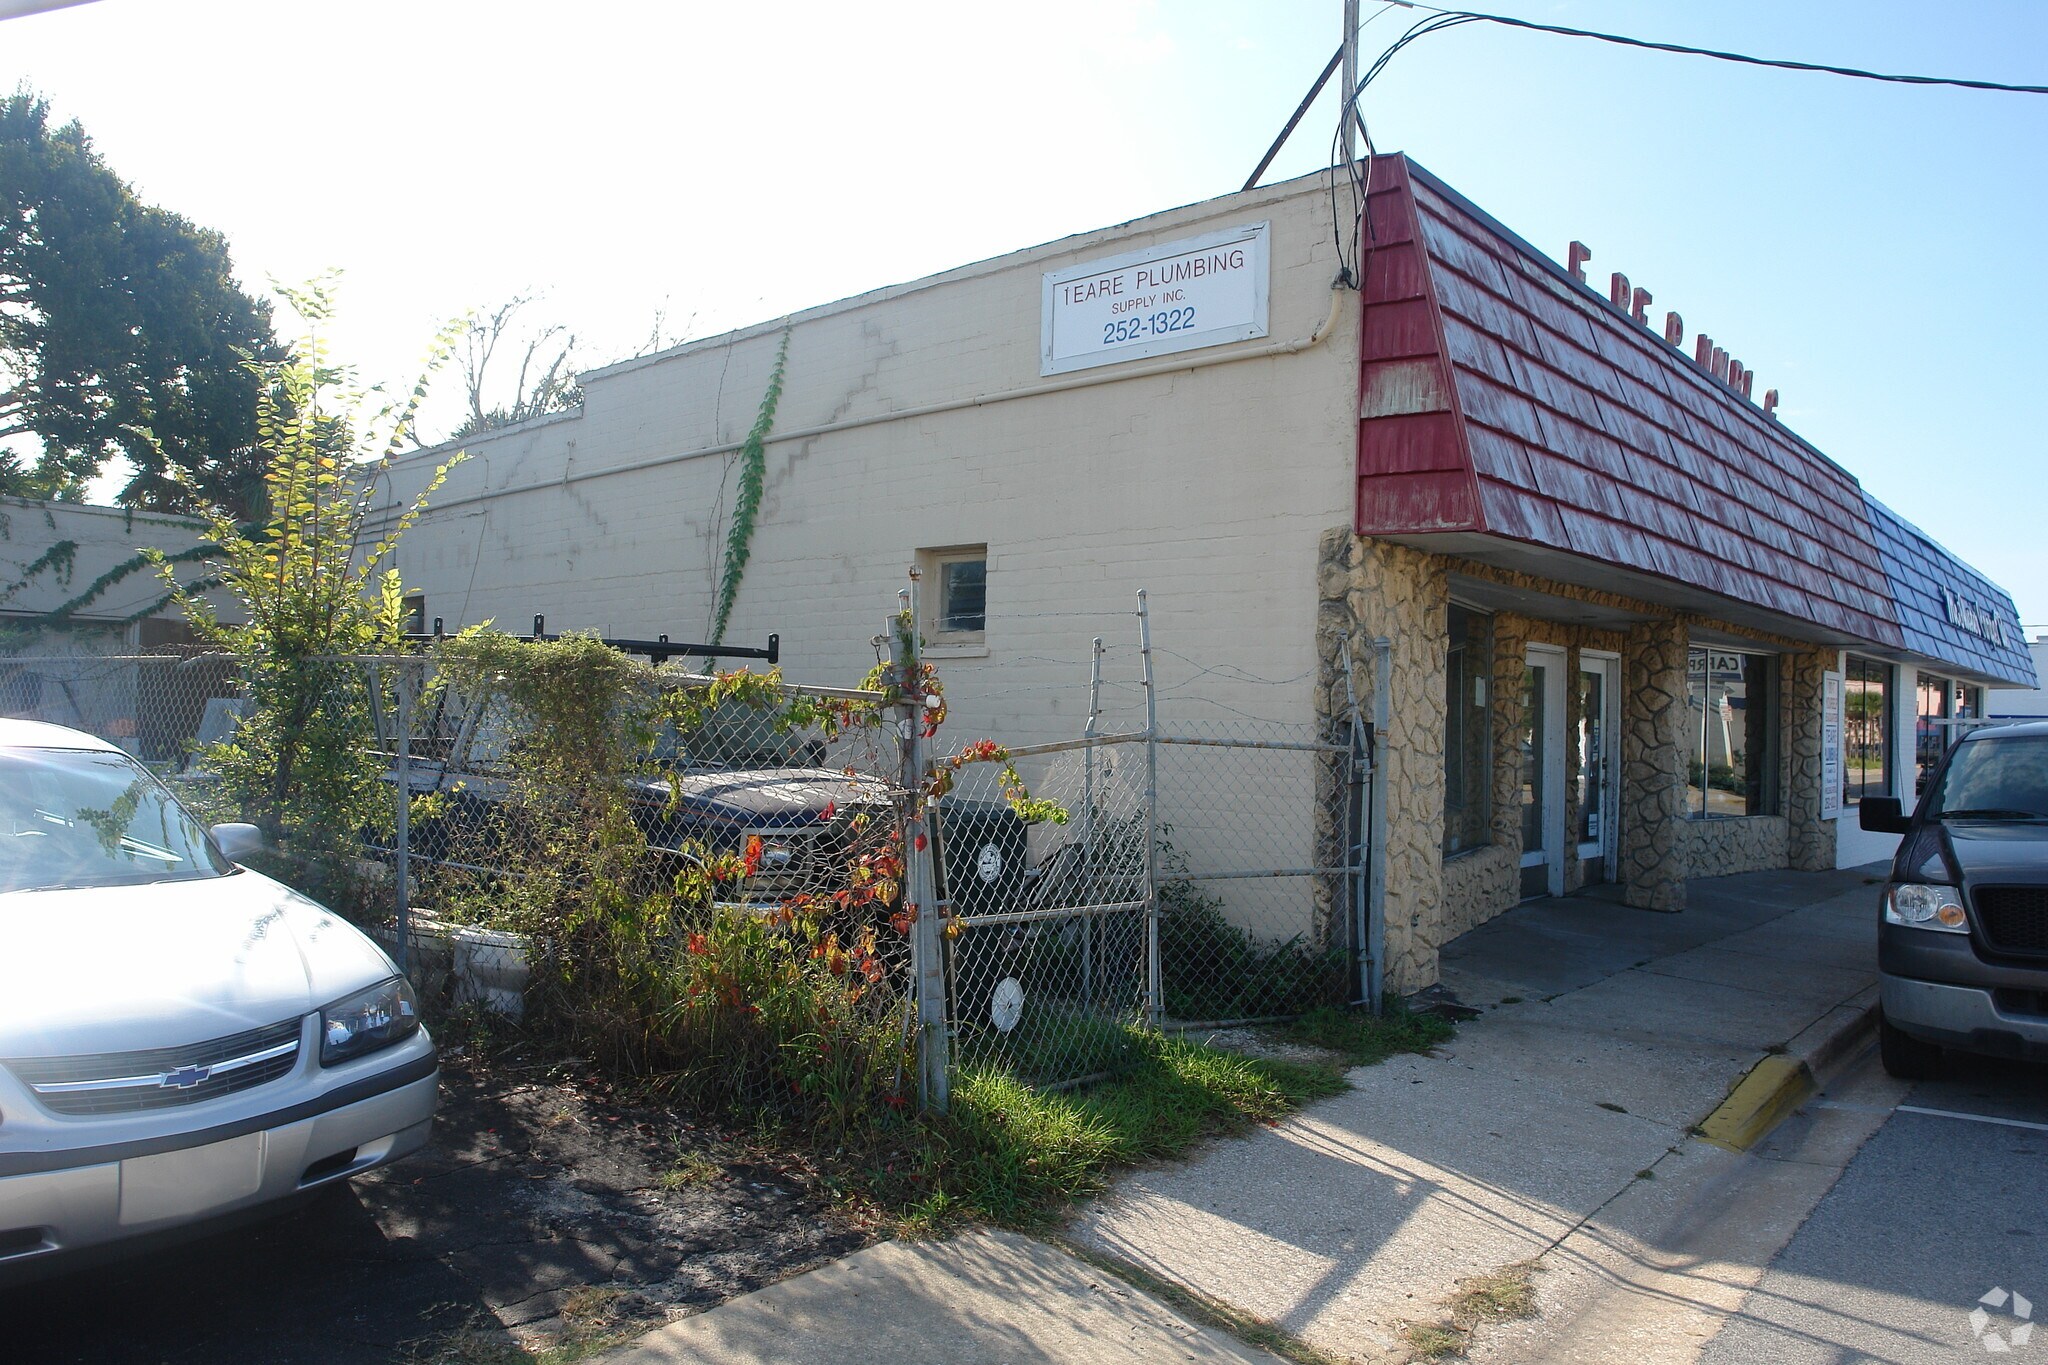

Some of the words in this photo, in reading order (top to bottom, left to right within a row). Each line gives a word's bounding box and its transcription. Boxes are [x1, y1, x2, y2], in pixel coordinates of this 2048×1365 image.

[1136, 250, 1245, 290] PLUMBING
[1111, 294, 1157, 315] SUPPLY
[1162, 288, 1186, 303] INC.
[1103, 306, 1195, 345] 252-1322
